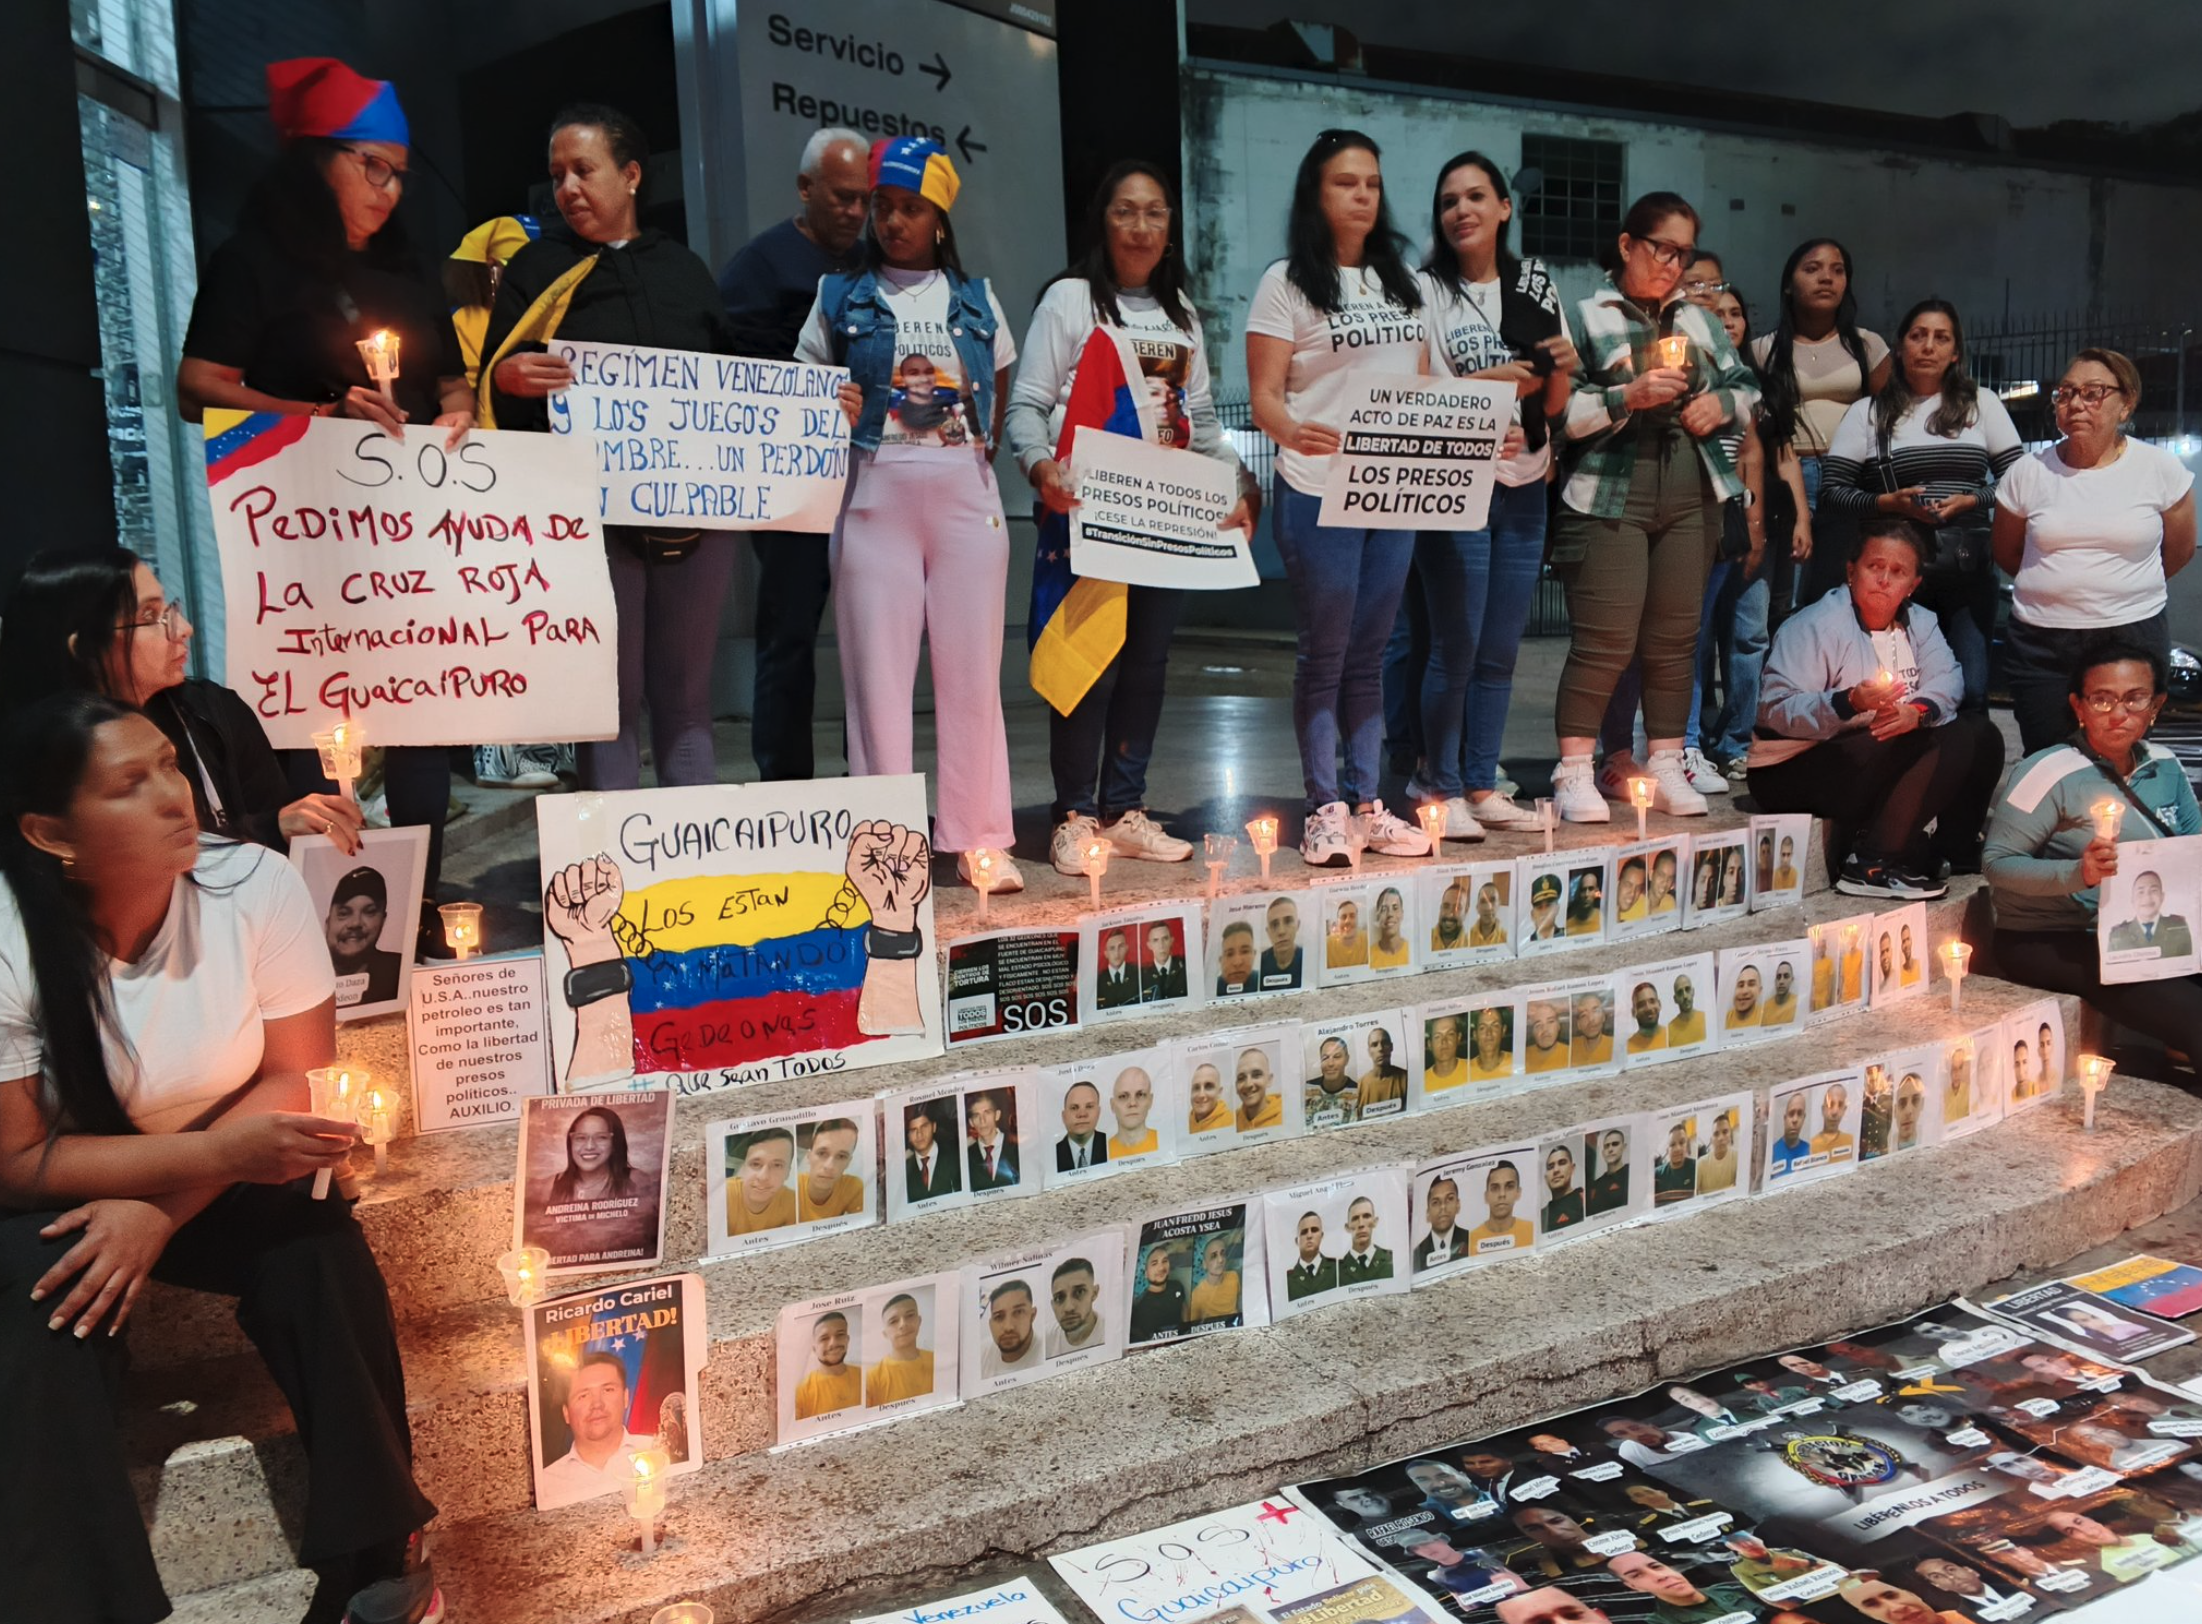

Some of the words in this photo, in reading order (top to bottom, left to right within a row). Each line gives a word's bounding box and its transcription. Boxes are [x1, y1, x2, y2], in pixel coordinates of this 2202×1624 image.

[768, 14, 904, 76] Servicio
[772, 82, 946, 148] Repuestos
[1328, 312, 1364, 330] LOS
[1449, 336, 1479, 359] LOS
[717, 359, 848, 400] VENEZOLANO
[1370, 388, 1391, 403] UN
[1396, 391, 1491, 410] VERDADERO
[594, 397, 650, 432] LOS
[669, 399, 779, 435] JUEGOS
[801, 408, 847, 440] DEL
[1350, 410, 1392, 424] ACTO
[1397, 412, 1418, 426] DE
[1424, 414, 1452, 428] PAZ
[1457, 416, 1475, 429] ES
[1479, 417, 1496, 431] LA
[1346, 435, 1419, 453] LIBERTAD
[1423, 439, 1442, 454] DE
[1446, 441, 1493, 457] TODOS
[337, 433, 496, 492] S.O.S
[760, 441, 848, 479] PERDÓN
[1348, 465, 1390, 485] LOS
[1396, 467, 1473, 487] PRESOS
[630, 482, 771, 520] CULPABLE
[1082, 486, 1142, 508] PRESOS
[1146, 481, 1154, 491] A
[1158, 483, 1201, 500] TODOS
[1205, 492, 1227, 505] LOS
[1344, 488, 1466, 514] POLÍTICOS
[428, 509, 533, 556] AYUDA
[1094, 511, 1127, 525] ¡CESE
[1131, 517, 1145, 526] LA
[1149, 520, 1218, 540] REPRESIÓN!
[341, 570, 434, 604] CRUZ
[459, 558, 550, 604] ROJA
[252, 670, 306, 717] EL
[620, 809, 852, 871] GUAICAIPURO
[642, 899, 695, 932] LOS
[433, 969, 493, 986] Señores
[499, 967, 516, 979] de
[955, 976, 989, 987] TORTURA
[421, 1006, 482, 1024] petroleo
[487, 1005, 503, 1014] es
[508, 1000, 531, 1011] tan
[1004, 999, 1068, 1033] SOS
[435, 1019, 519, 1037] importante,
[1318, 1024, 1354, 1037] Alejandro
[1356, 1018, 1379, 1030] Torres
[418, 1042, 461, 1056] Como
[466, 1037, 479, 1050] la
[483, 1031, 538, 1048] libertad
[436, 1058, 454, 1071] de
[458, 1051, 522, 1069] nuestros
[455, 1069, 505, 1086] presos
[446, 1085, 516, 1106] políticos..
[542, 1096, 588, 1109] PRIVADA
[591, 1095, 604, 1106] DE
[607, 1092, 656, 1106] LIBERTAD
[449, 1100, 516, 1119] AUXILIO.
[1317, 1112, 1340, 1122] Antes
[1366, 1101, 1397, 1115] Después
[1443, 1167, 1465, 1178] Jeremy
[546, 1203, 589, 1215] ANDREINA
[592, 1197, 638, 1211] RODRÍGUEZ
[556, 1213, 587, 1223] VICTIMA
[597, 1210, 628, 1220] MICHELO
[1207, 1207, 1233, 1220] JESUS
[812, 1220, 848, 1233] Después
[1162, 1225, 1197, 1238] ACOSTA
[1199, 1221, 1221, 1233] YSEA
[742, 1236, 769, 1246] Antes
[1480, 1238, 1511, 1250] Después
[579, 1252, 600, 1263] PARA
[602, 1248, 644, 1260] ANDREINA!
[990, 1260, 1019, 1272] Wilmer
[1021, 1251, 1053, 1264] Salinas
[545, 1298, 616, 1323] Ricardo
[620, 1284, 673, 1306] Cariel
[810, 1299, 832, 1311] Jose
[1152, 1329, 1179, 1340] ANTES
[1191, 1320, 1226, 1333] DESPUES
[1055, 1353, 1089, 1367] Después
[992, 1375, 1017, 1387] Antes
[878, 1398, 916, 1412] Después
[814, 1410, 842, 1423] Antes
[1854, 1498, 1932, 1530] LIBÉRENLOS
[1929, 1495, 1942, 1504] A
[1937, 1480, 1986, 1499] TODOS
[1117, 1555, 1323, 1622] Guaicaipuro
[903, 1590, 1028, 1624] Venezuela
[1280, 1610, 1291, 1619] El
[1291, 1601, 1322, 1616] Estado
[1297, 1588, 1384, 1624] #Libertad
